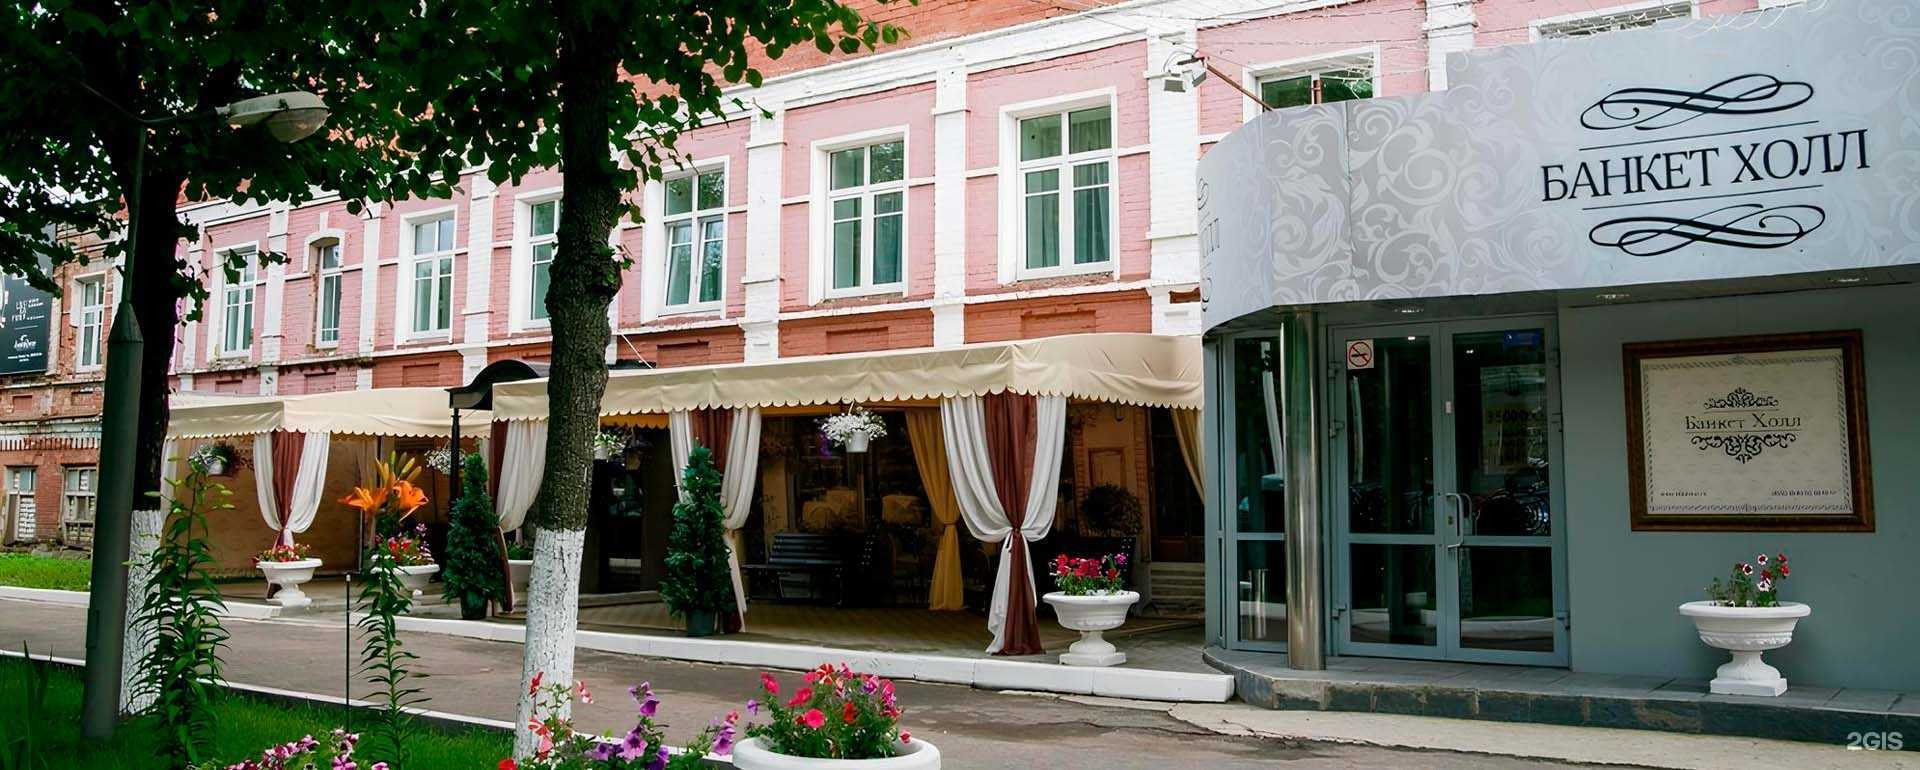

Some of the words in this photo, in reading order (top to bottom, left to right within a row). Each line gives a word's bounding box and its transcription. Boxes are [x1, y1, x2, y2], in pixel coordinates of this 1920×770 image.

[1541, 147, 1720, 202] БАНКЕТ
[1730, 129, 1871, 184] ХОЛЛ
[1685, 415, 1745, 430] Банкет
[1752, 412, 1801, 428] Холл
